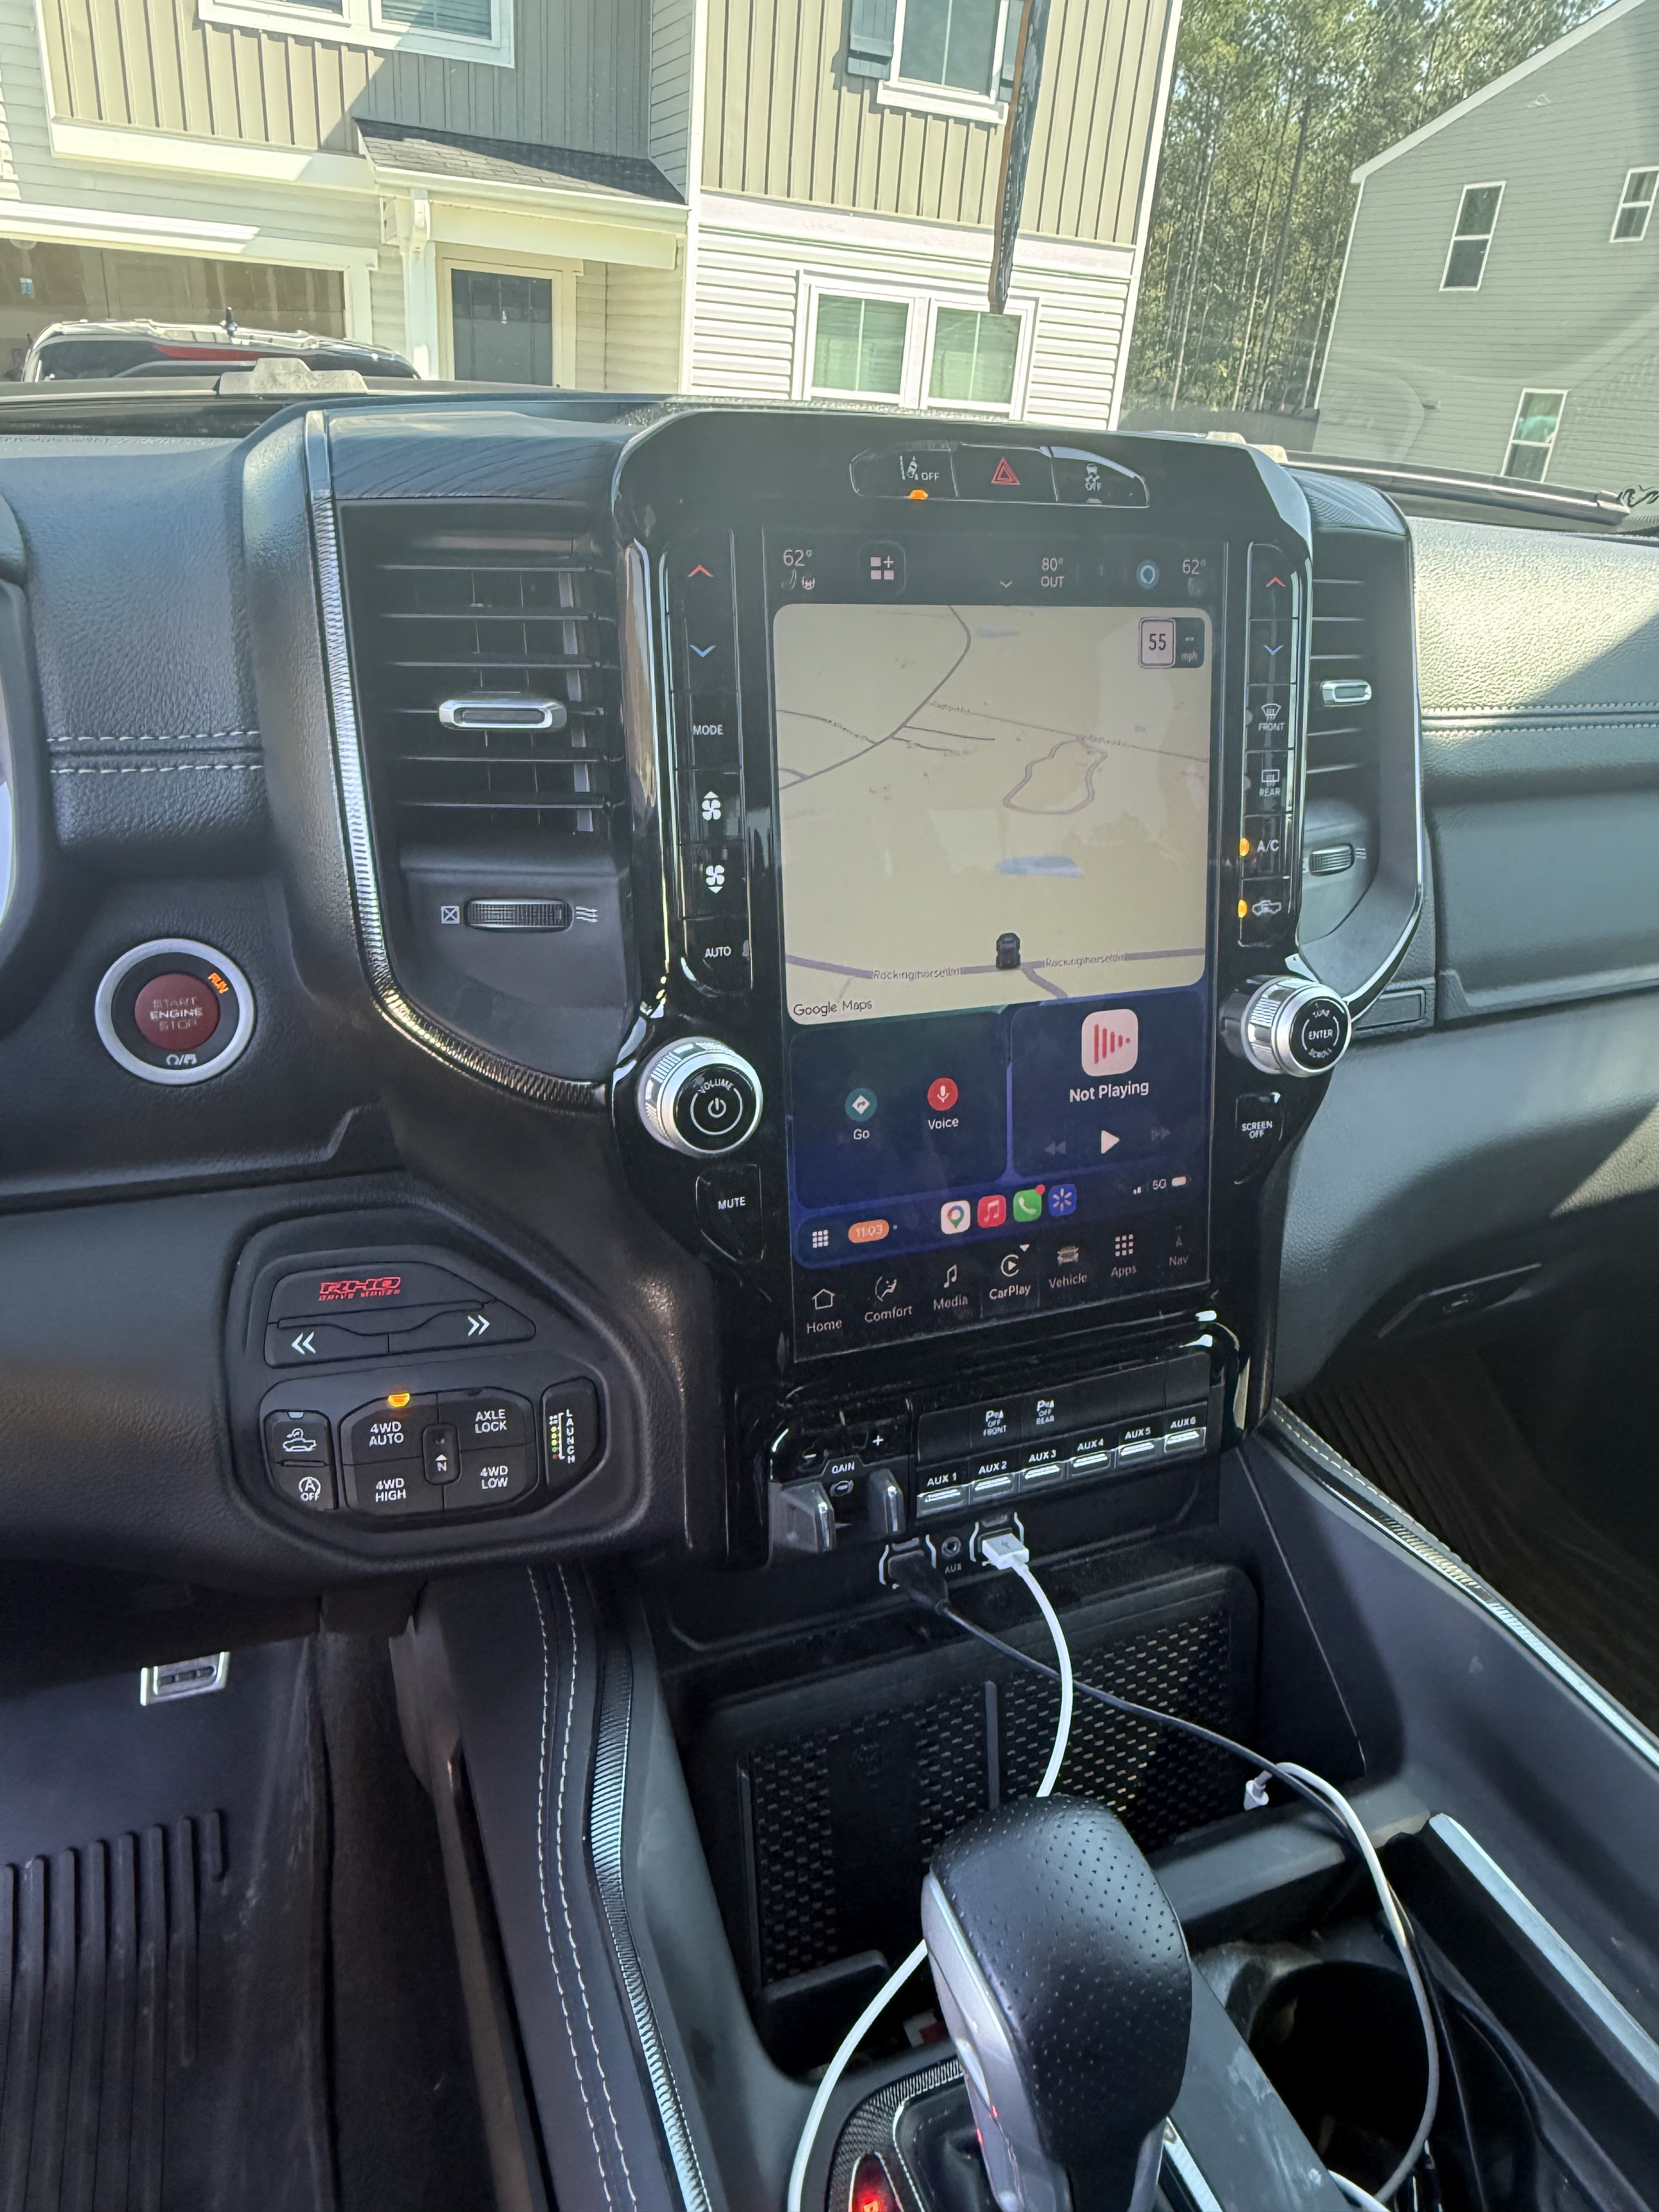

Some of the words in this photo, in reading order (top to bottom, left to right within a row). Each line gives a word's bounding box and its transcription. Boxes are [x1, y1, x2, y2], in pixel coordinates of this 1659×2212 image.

[921, 472, 939, 481] OFF
[1041, 576, 1064, 588] OUT
[1149, 633, 1166, 651] 55
[693, 724, 724, 736] MODE
[1258, 722, 1285, 731] FRONT
[1259, 787, 1280, 797] REAR
[1257, 840, 1280, 852] A/C
[704, 946, 731, 957] AUTO
[150, 1007, 203, 1020] ENGINE
[793, 1001, 837, 1017] Google
[842, 1000, 873, 1011] Maps
[1308, 1029, 1333, 1040] ENTER
[697, 1078, 734, 1093] VOLUME
[1069, 1087, 1095, 1103] Not
[1098, 1080, 1149, 1099] Playing
[928, 1117, 959, 1130] Voice
[1242, 1120, 1273, 1132] SCREEN
[853, 1128, 870, 1140] Go
[718, 1197, 746, 1209] MUTE
[1169, 1255, 1188, 1266] Nav
[1111, 1265, 1137, 1278] Apps
[1048, 1272, 1087, 1289] Vehicle
[989, 1284, 1031, 1300] CarPlay
[933, 1294, 968, 1311] Media
[864, 1305, 913, 1323] Comfort
[806, 1319, 843, 1334] Home
[475, 1409, 506, 1422] AXLE
[370, 1421, 402, 1434] 4WD
[475, 1420, 507, 1434] LOCK
[1170, 1418, 1190, 1429] AUX
[369, 1432, 404, 1447] AUTO
[566, 1409, 575, 1464] LAUNCH
[1125, 1429, 1144, 1440] AUX
[1145, 1427, 1152, 1435] 5
[1076, 1439, 1098, 1452] AUX
[1098, 1438, 1104, 1447] 4
[1028, 1451, 1049, 1463] AUX
[1050, 1449, 1057, 1458] 3
[437, 1462, 448, 1472] N
[480, 1465, 509, 1477] 4WD
[978, 1463, 1000, 1475] AUX
[1001, 1460, 1008, 1470] 2
[375, 1477, 405, 1490] 4WD
[481, 1477, 509, 1489] LOW
[927, 1474, 949, 1487] AUX
[952, 1472, 957, 1481] 1
[301, 1492, 319, 1502] OFF
[375, 1488, 407, 1503] HIGH
